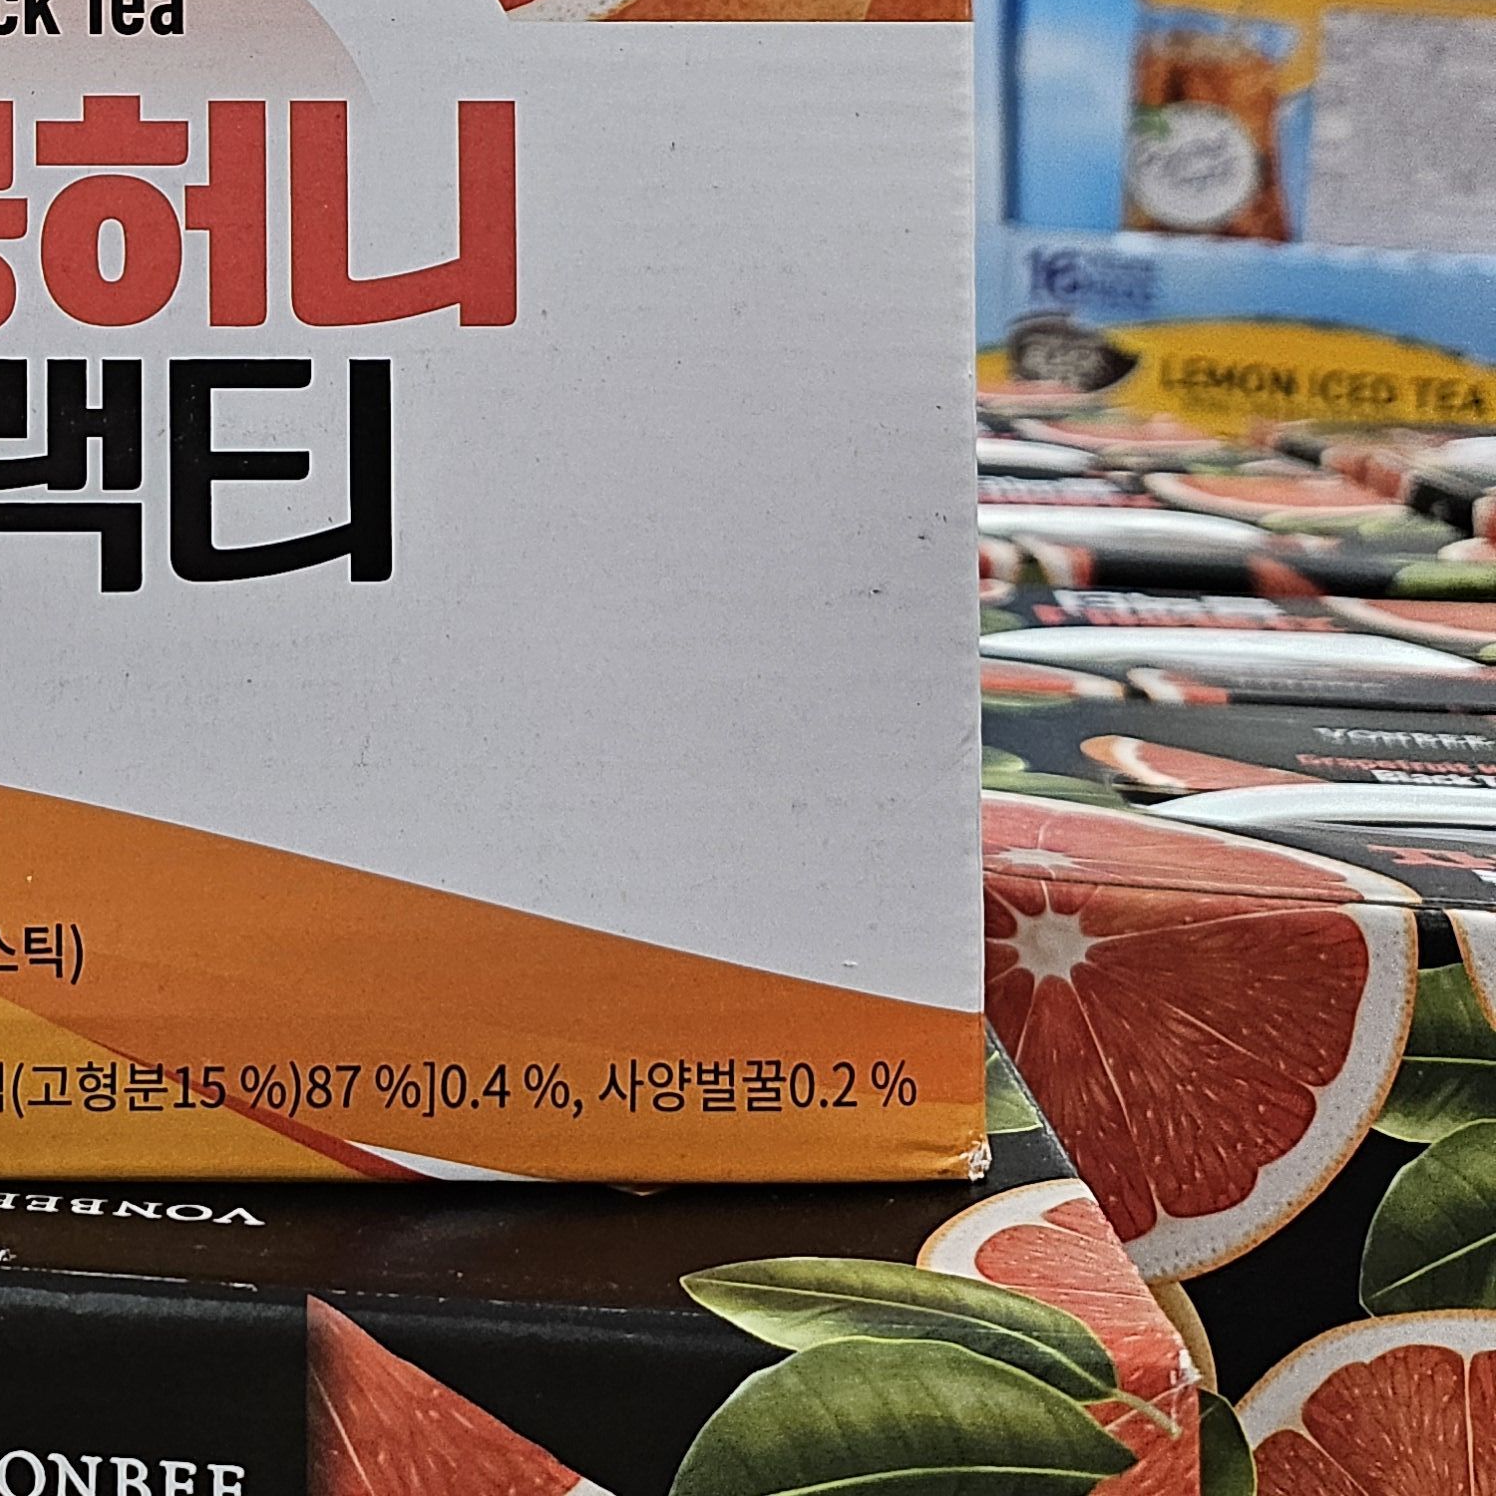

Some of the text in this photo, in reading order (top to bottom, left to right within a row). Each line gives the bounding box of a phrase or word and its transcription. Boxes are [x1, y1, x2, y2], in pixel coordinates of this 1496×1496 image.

[1160, 354, 1298, 398] LEMON
[1308, 368, 1397, 403] ICED
[1409, 375, 1490, 415] TEA
[598, 1057, 858, 1113] 사양벌꿀0.2
[870, 1058, 918, 1108] %
